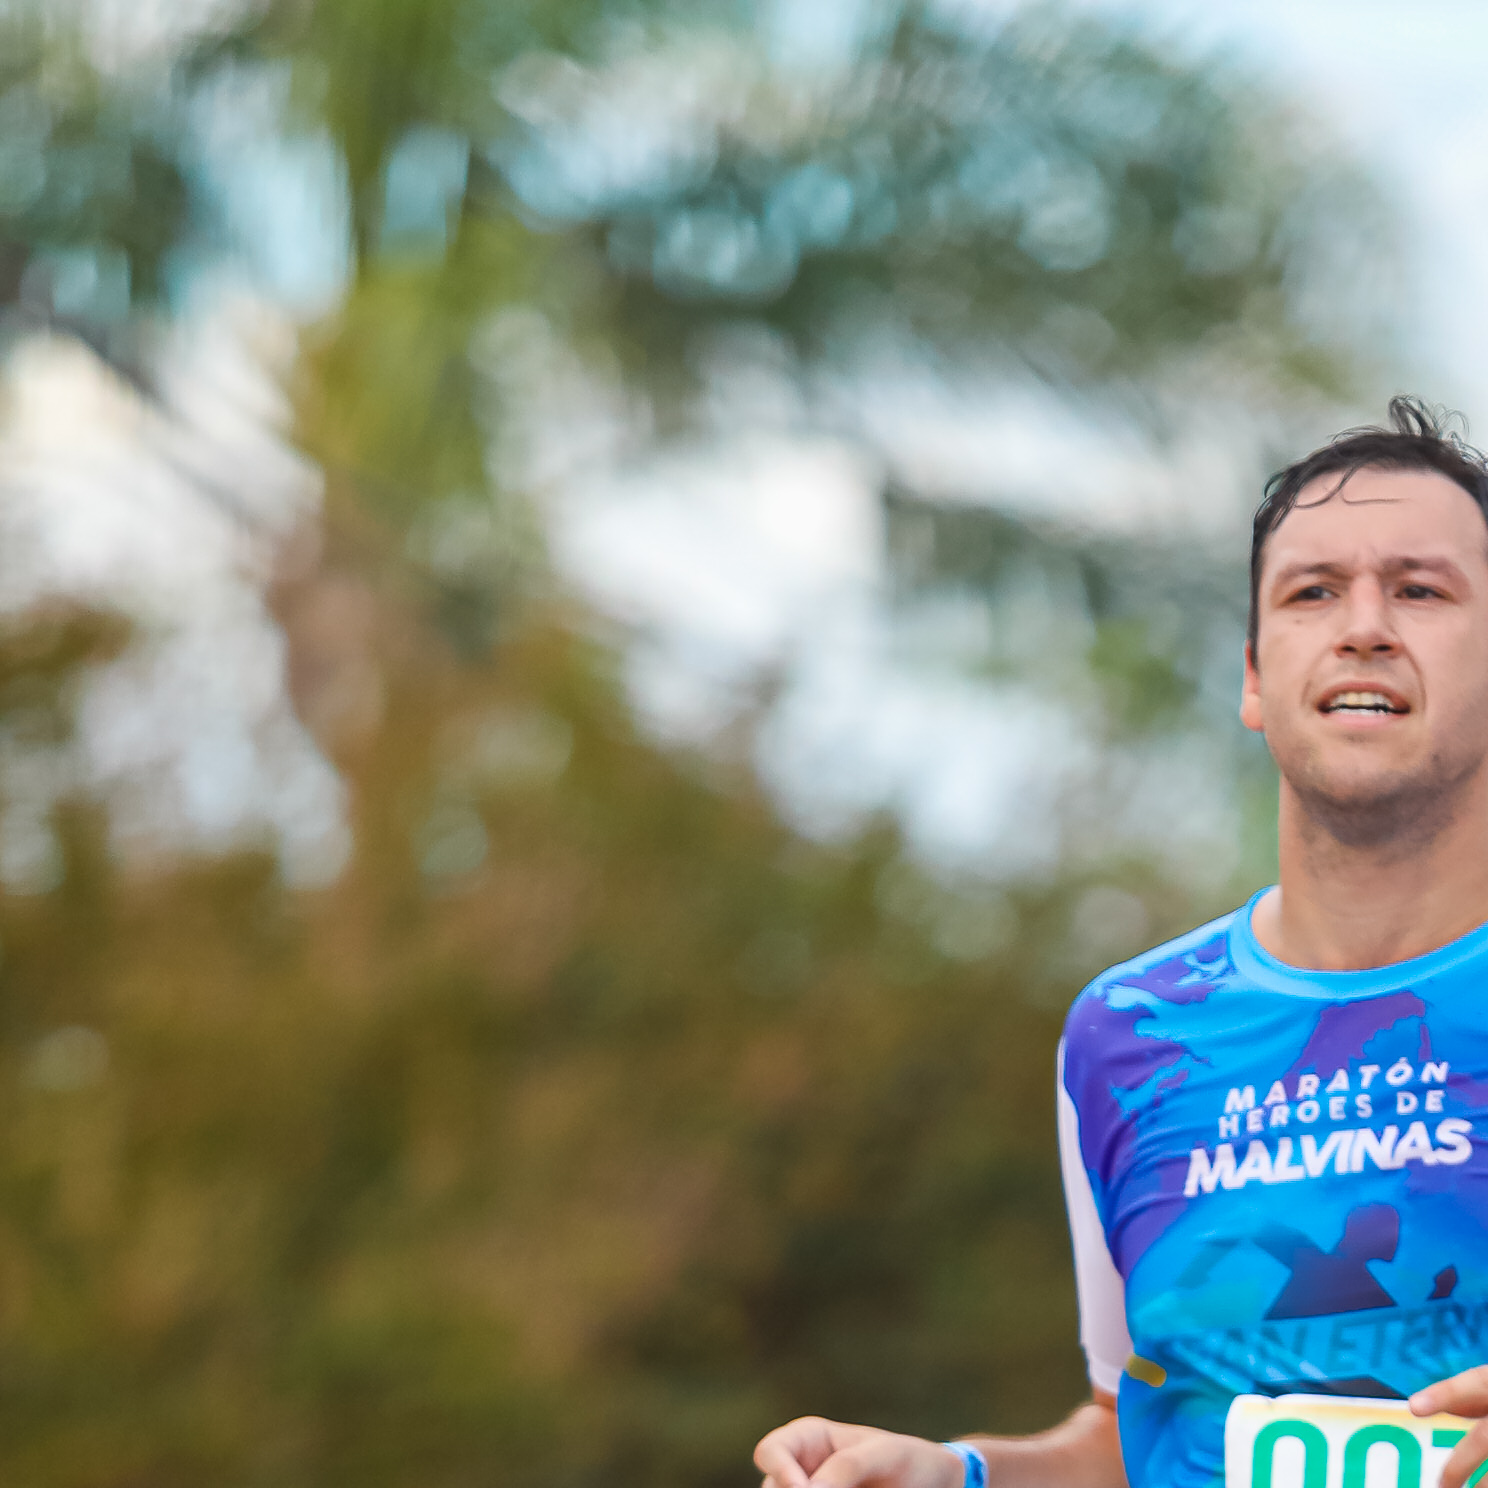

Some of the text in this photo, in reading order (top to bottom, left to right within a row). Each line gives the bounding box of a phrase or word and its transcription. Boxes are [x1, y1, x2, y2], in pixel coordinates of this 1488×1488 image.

[1218, 1089, 1445, 1138] HEROES DE
[1224, 1057, 1449, 1114] MARATÓN
[1183, 1118, 1472, 1197] MALVINAS
